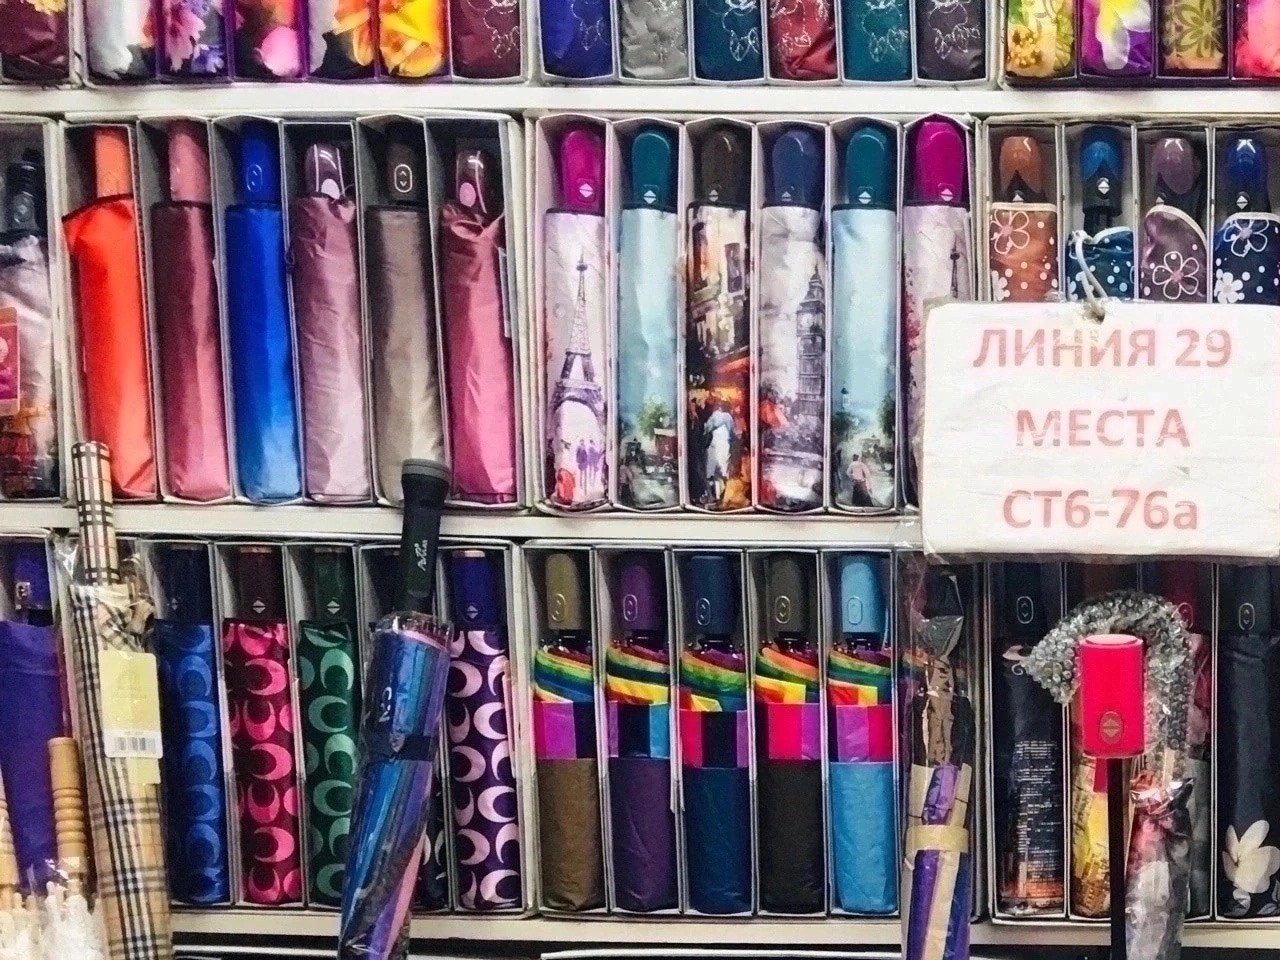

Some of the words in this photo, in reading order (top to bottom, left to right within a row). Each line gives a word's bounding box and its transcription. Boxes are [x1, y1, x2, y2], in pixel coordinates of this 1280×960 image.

[973, 327, 1156, 368] ЛИНИЯ
[1175, 328, 1232, 368] 29
[1015, 408, 1191, 447] МЕСТА
[1002, 489, 1198, 530] СТ6-76а
